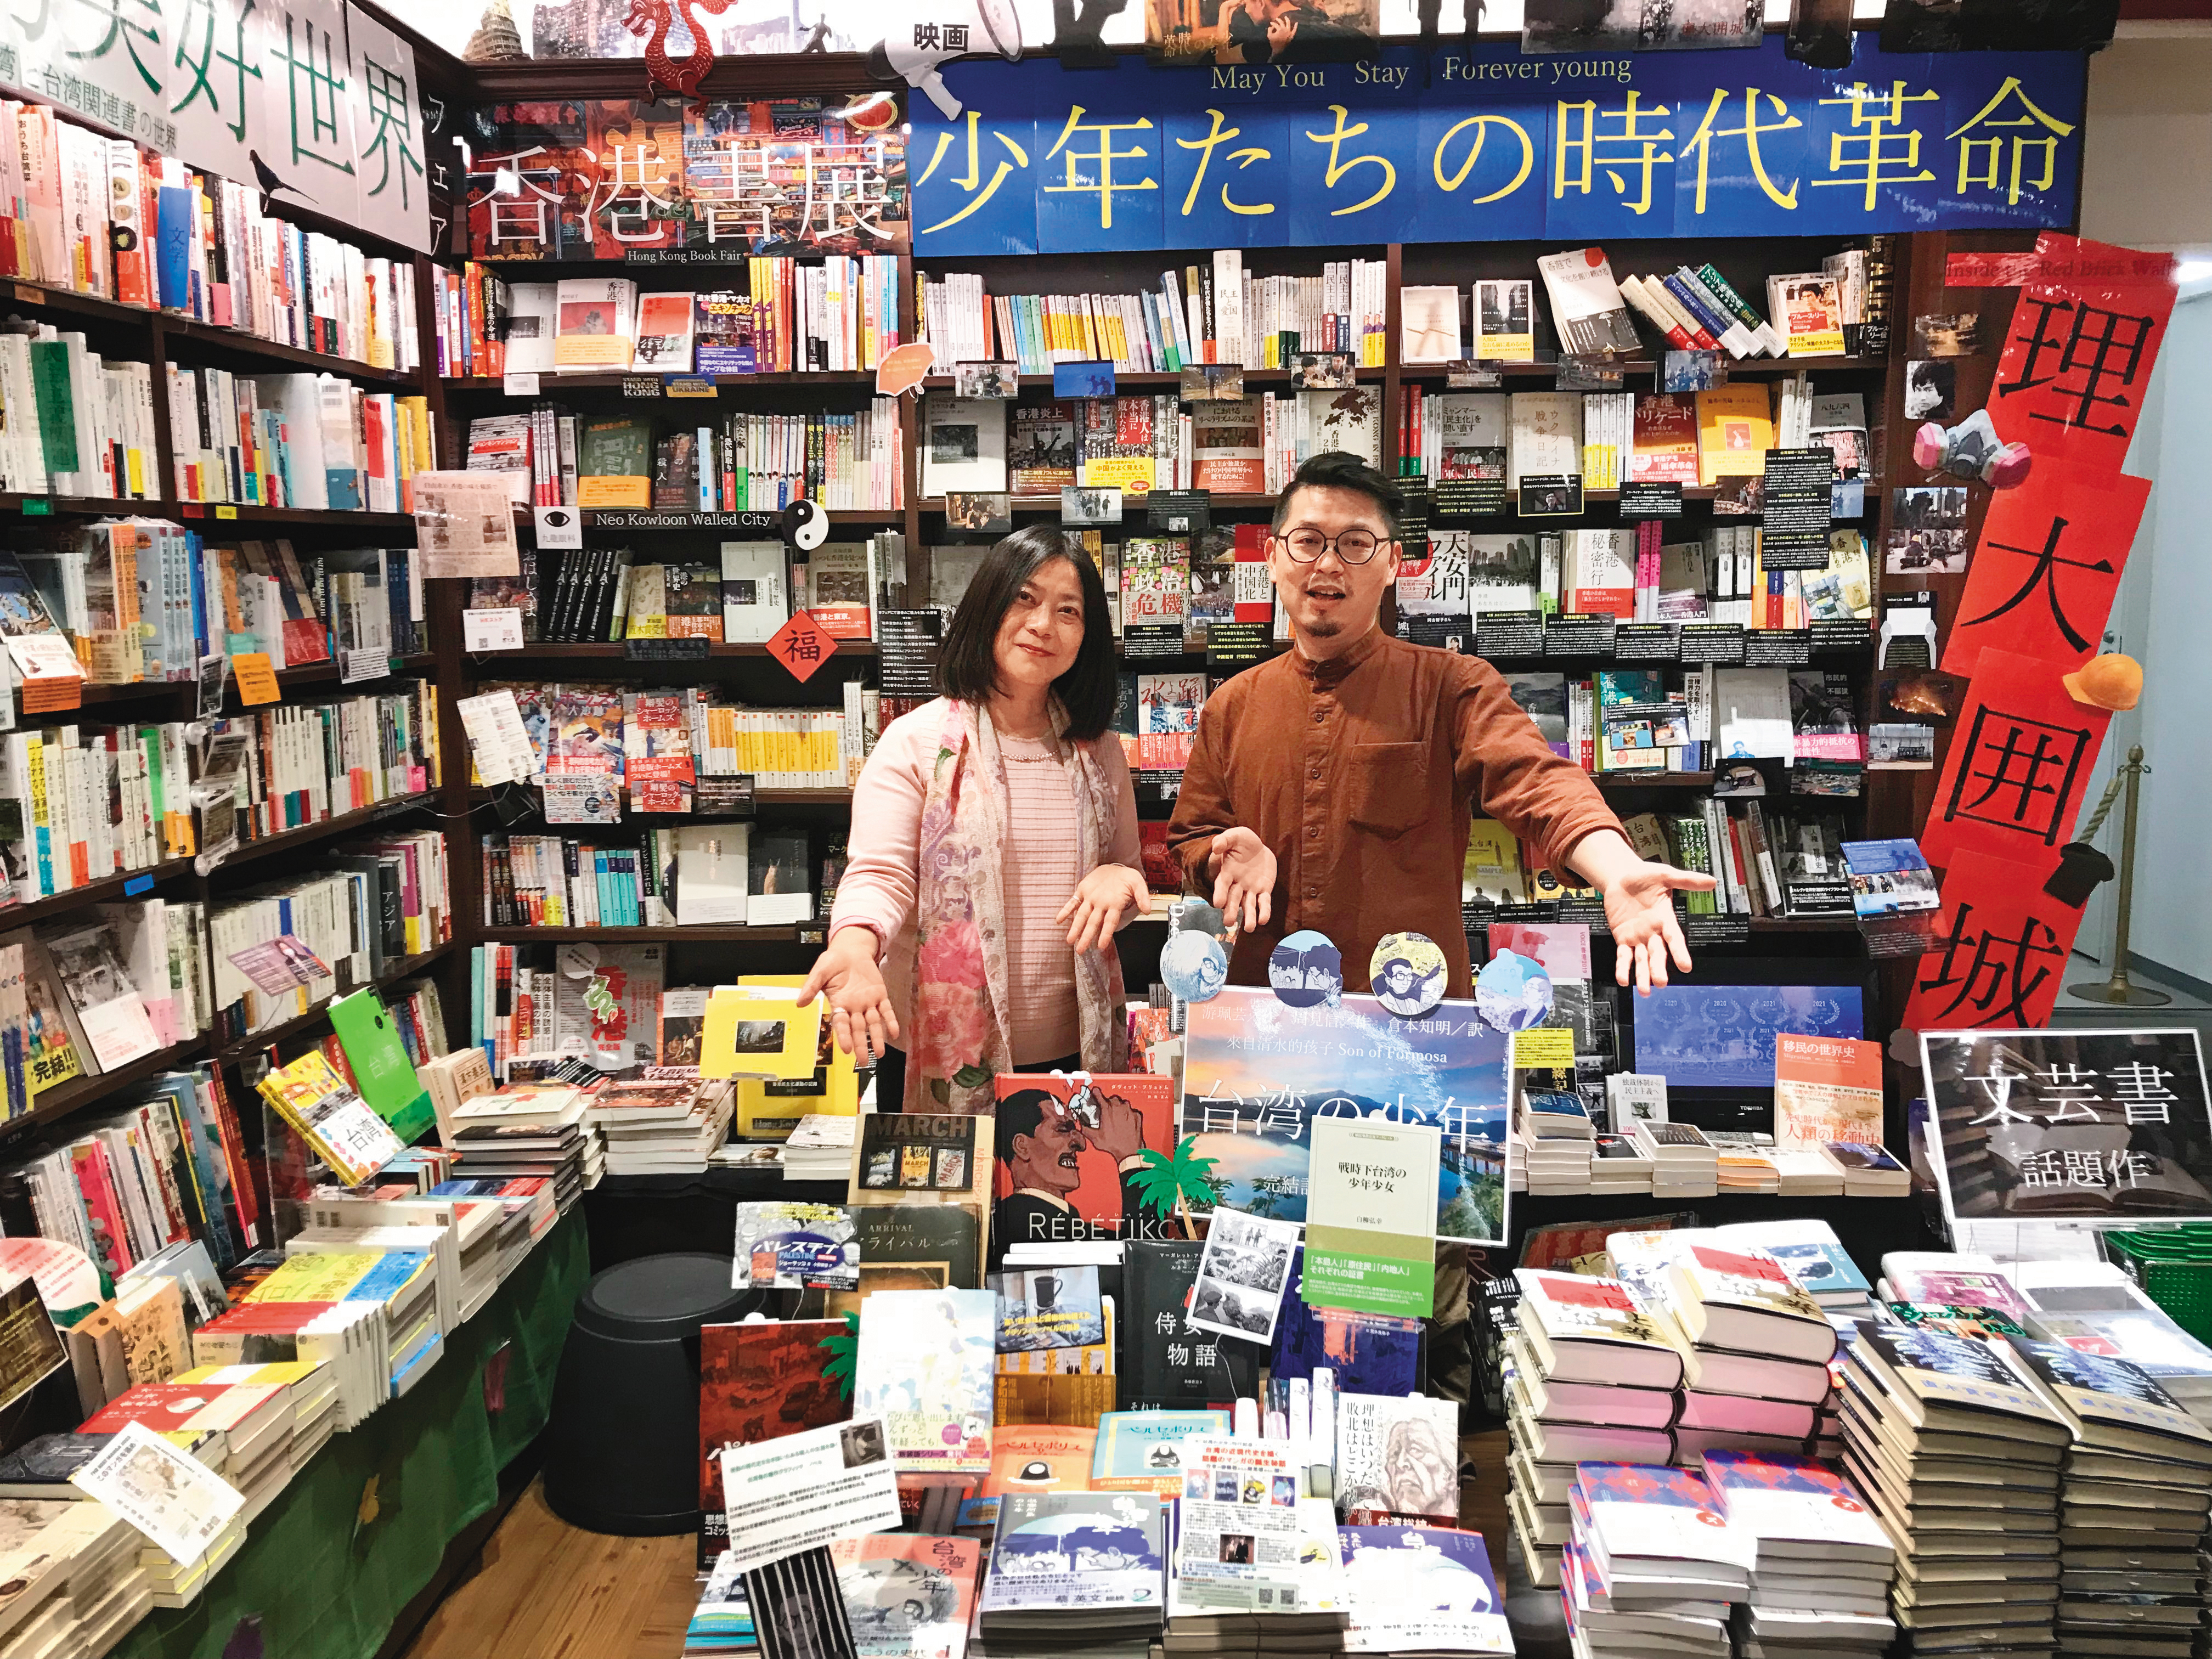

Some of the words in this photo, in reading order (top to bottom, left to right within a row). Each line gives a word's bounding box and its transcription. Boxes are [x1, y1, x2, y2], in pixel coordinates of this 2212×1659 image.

[913, 23, 969, 52] 映画
[1211, 66, 1267, 94] May
[1276, 64, 1325, 88] You
[1355, 61, 1409, 89] Stay
[1444, 56, 1544, 81] Forever
[1551, 59, 1632, 83] young
[915, 76, 2076, 235] 少年たちの時代革命
[427, 93, 447, 257] フェア
[469, 140, 895, 248] 香港書展
[168, 227, 185, 267] 文学
[628, 250, 656, 267] Hong
[659, 250, 689, 267] Kong
[690, 250, 716, 262] Book
[718, 249, 741, 262] Fair
[1546, 257, 1572, 272] 香港で
[1946, 261, 1998, 278] Inside
[2040, 259, 2074, 276] Red
[607, 281, 617, 301] 香港
[696, 294, 751, 303] 週末香港・マカオ
[1326, 274, 1336, 314] 民主主義
[1339, 274, 1349, 315] 民主主義
[624, 388, 660, 397] KONG
[1643, 394, 1674, 408] 香港
[1016, 407, 1064, 420] 香港炎上
[1118, 399, 1128, 442] 敗れたのか
[1128, 399, 1138, 431] 本当に
[1139, 399, 1150, 442] 香港人は
[1442, 415, 1481, 424] 「民主化」を
[1443, 424, 1475, 433] 問い直す
[1536, 410, 1548, 467] 戦争日記
[1550, 410, 1561, 467] ウクライナ
[1096, 464, 1145, 472] 中国がよく見える
[596, 514, 624, 526] Neo
[628, 513, 687, 526] Kowloon
[691, 513, 738, 526] Walled
[741, 513, 771, 528] City
[1133, 541, 1181, 565] 香港
[1591, 533, 1606, 586] 秘密行
[1606, 533, 1620, 568] 香港
[1424, 539, 1442, 601] ファイル
[1442, 532, 1468, 601] 天安門
[672, 567, 681, 591] 世界史
[1134, 570, 1182, 592] 政治
[1244, 565, 1256, 600] 中国化
[1257, 565, 1269, 600] 香港と
[1137, 592, 1183, 616] 危機
[783, 629, 821, 663] 福
[1602, 673, 1618, 704] 香港
[642, 714, 675, 723] ホームズ
[1793, 736, 1855, 747] 非暴力的抵抗の
[1793, 746, 1821, 757] 可能性
[630, 762, 682, 771] 香港版ホームズ
[382, 890, 396, 934] アジア
[1387, 1018, 1483, 1039] 倉本知明／訳
[1227, 1037, 1334, 1057] 來自清水的孩子
[1338, 1045, 1364, 1057] Son
[1368, 1045, 1384, 1060] of
[1387, 1046, 1448, 1064] Formosa
[1783, 1040, 1855, 1059] 移民の世界史
[33, 1048, 76, 1085] 完結!!
[1622, 1077, 1661, 1087] 独裁体制から
[1624, 1086, 1659, 1094] 民主主義へ
[1962, 1060, 2180, 1126] 文芸書
[346, 1117, 383, 1152] 台湾
[870, 1116, 969, 1138] MARCH
[870, 1162, 894, 1172] MARCH
[905, 1159, 929, 1167] MARCH
[1338, 1160, 1407, 1180] 戦時下台湾の
[2018, 1149, 2150, 1188] 話題作
[1348, 1177, 1396, 1194] 少年少女
[868, 1224, 915, 1233] ARRIVAL
[752, 1240, 840, 1255] パレスチナ
[859, 1236, 931, 1252] ライバル
[778, 1251, 816, 1261] PALESTINE
[1310, 1254, 1410, 1276] 「本島人」「原住民」「内地人」
[1310, 1263, 1365, 1280] それぞれの証言
[1167, 1344, 1217, 1367] 物語
[945, 1645, 951, 1658] 1
